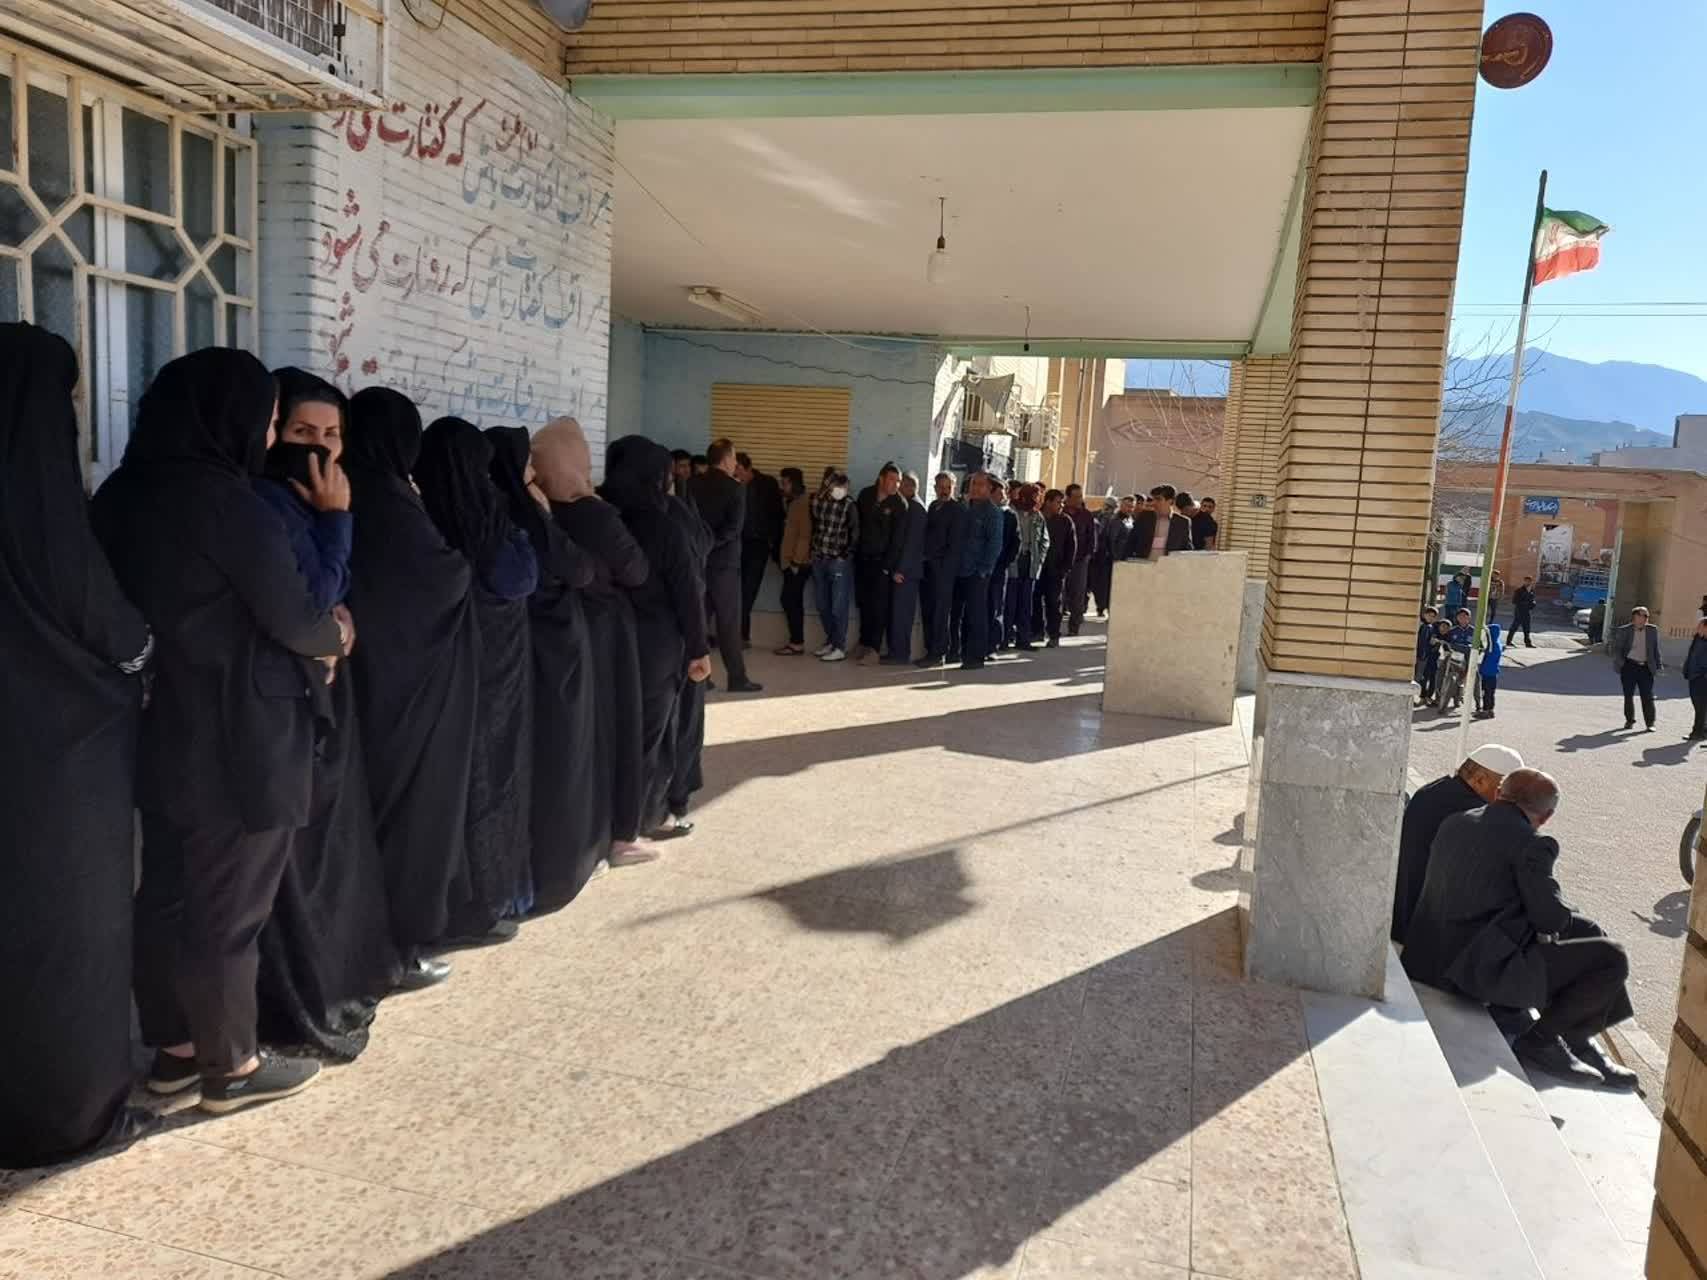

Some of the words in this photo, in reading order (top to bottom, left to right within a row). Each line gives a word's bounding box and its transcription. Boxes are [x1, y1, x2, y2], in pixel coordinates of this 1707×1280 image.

[445, 97, 488, 166] که
[320, 188, 362, 274] شود
[351, 220, 390, 294] می
[451, 225, 493, 295] که
